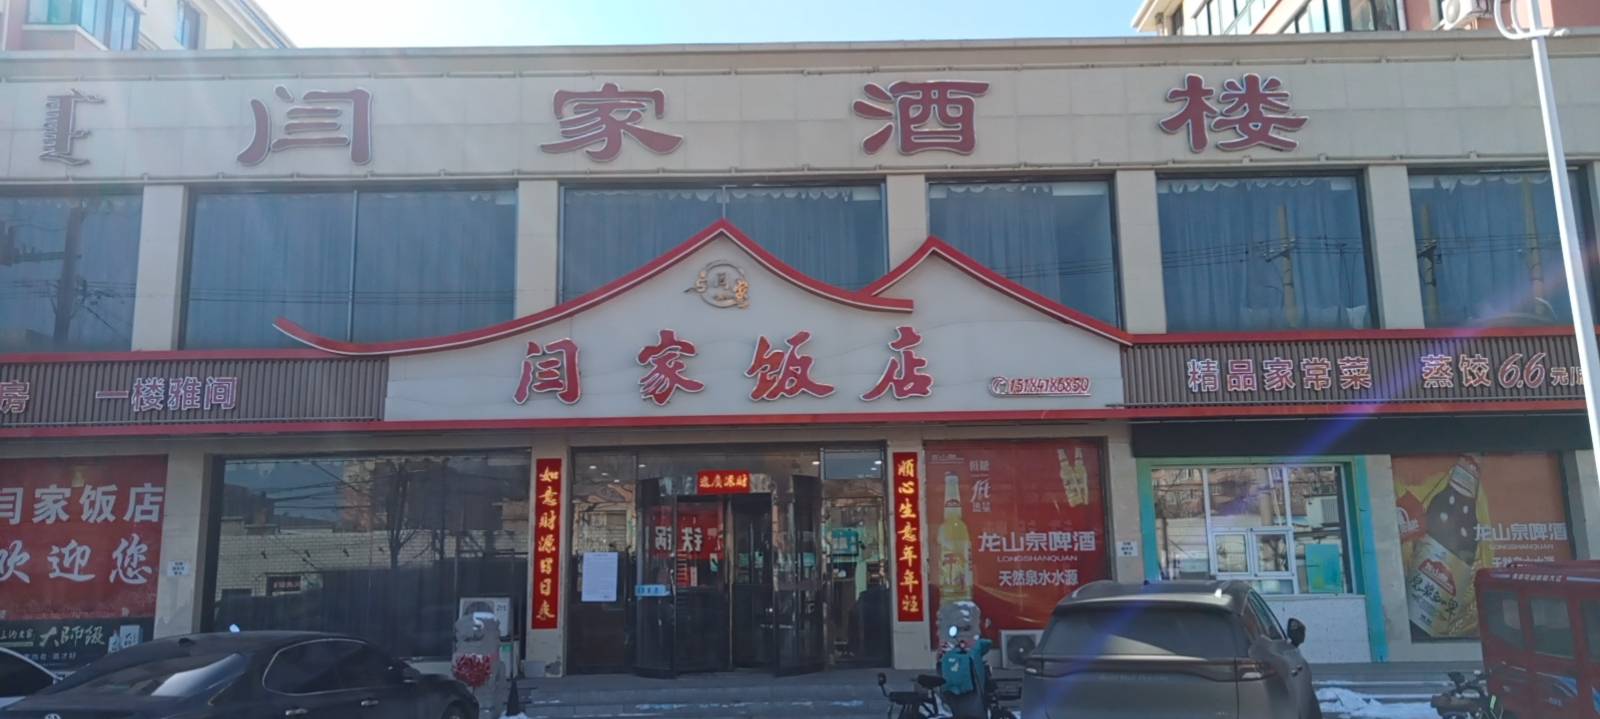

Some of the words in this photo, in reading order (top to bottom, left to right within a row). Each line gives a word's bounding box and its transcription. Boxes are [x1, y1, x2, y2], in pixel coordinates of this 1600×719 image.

[237, 73, 1308, 165] 闫家酒楼
[513, 326, 933, 405] 闫家饭店
[1187, 356, 1373, 393] 精品家常菜
[95, 376, 238, 413] 一楼雅间
[977, 530, 1096, 553] 龙山泉啤酒
[1473, 522, 1568, 540] 龙山泉啤酒
[0, 532, 152, 585] 欢迎您
[997, 554, 1078, 562] LONGSHANQUAN
[999, 568, 1079, 586] 天然泉水水源
